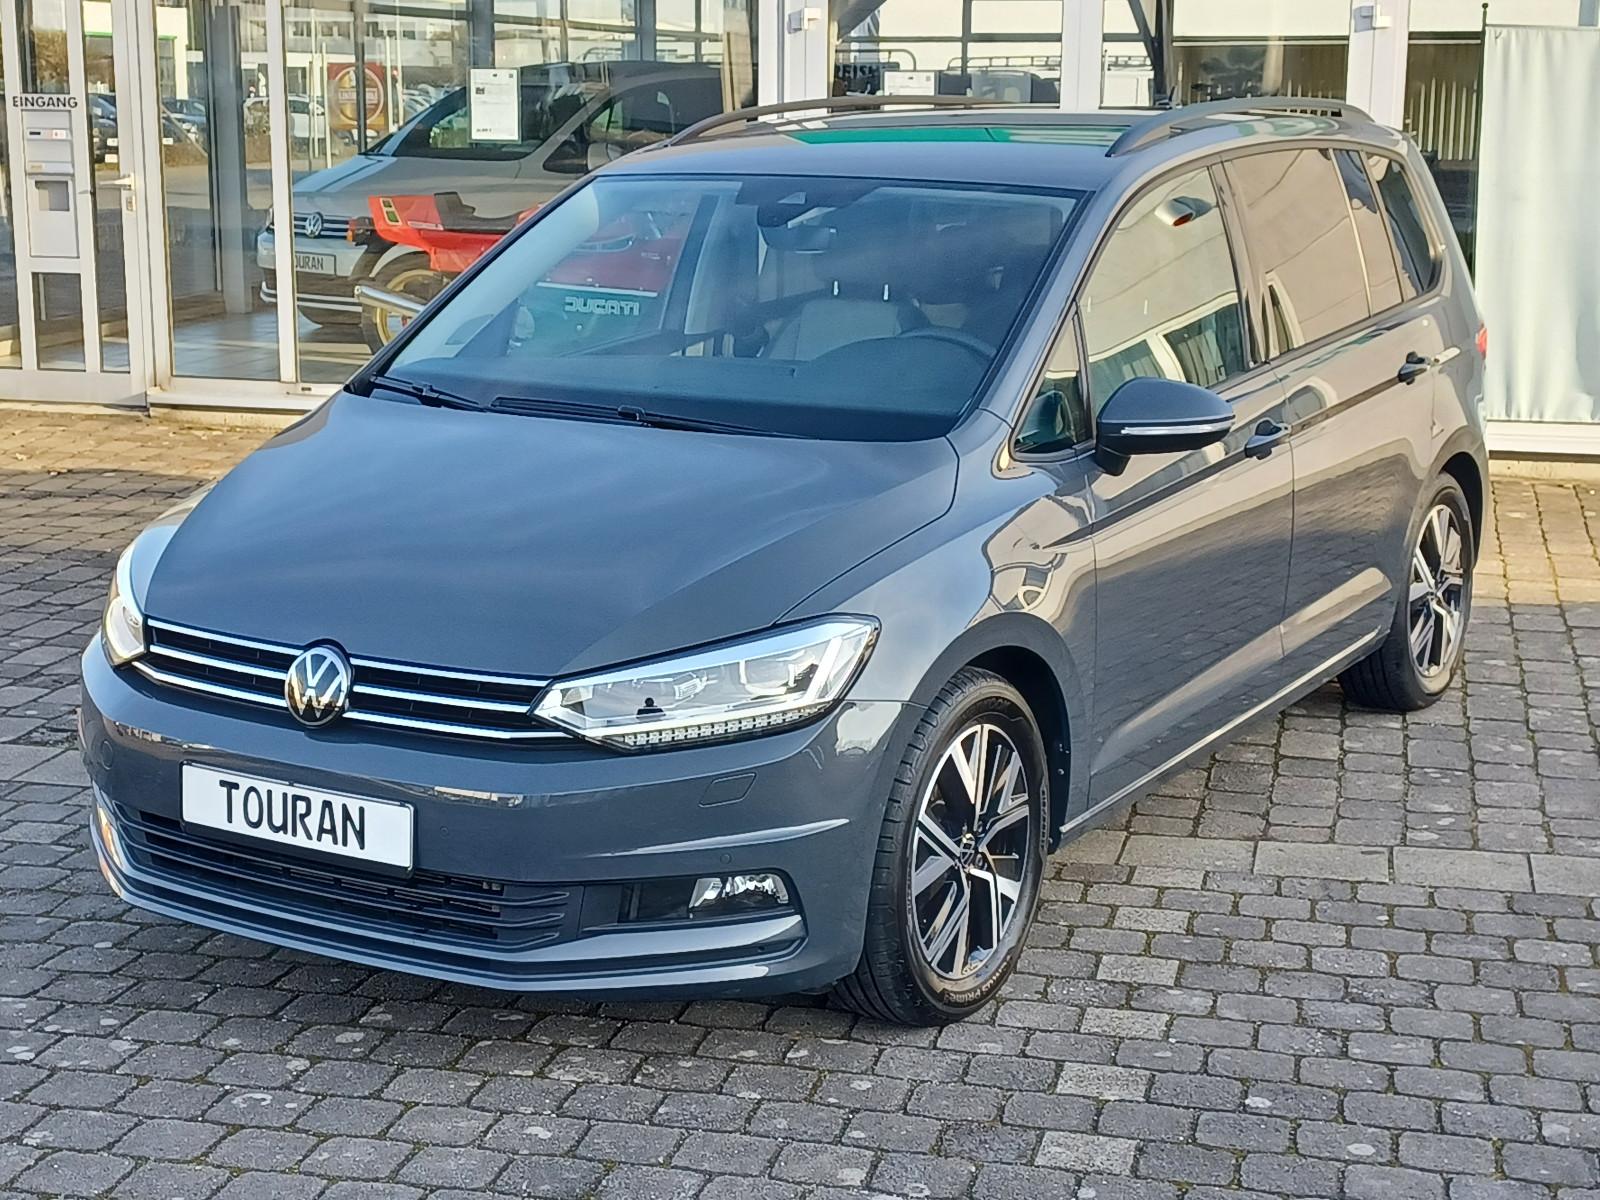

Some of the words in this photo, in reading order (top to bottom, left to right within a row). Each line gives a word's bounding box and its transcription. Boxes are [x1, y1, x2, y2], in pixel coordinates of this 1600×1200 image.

[12, 96, 78, 108] EINGANG
[564, 296, 640, 316] DUCATI
[219, 779, 365, 850] TOURAN
